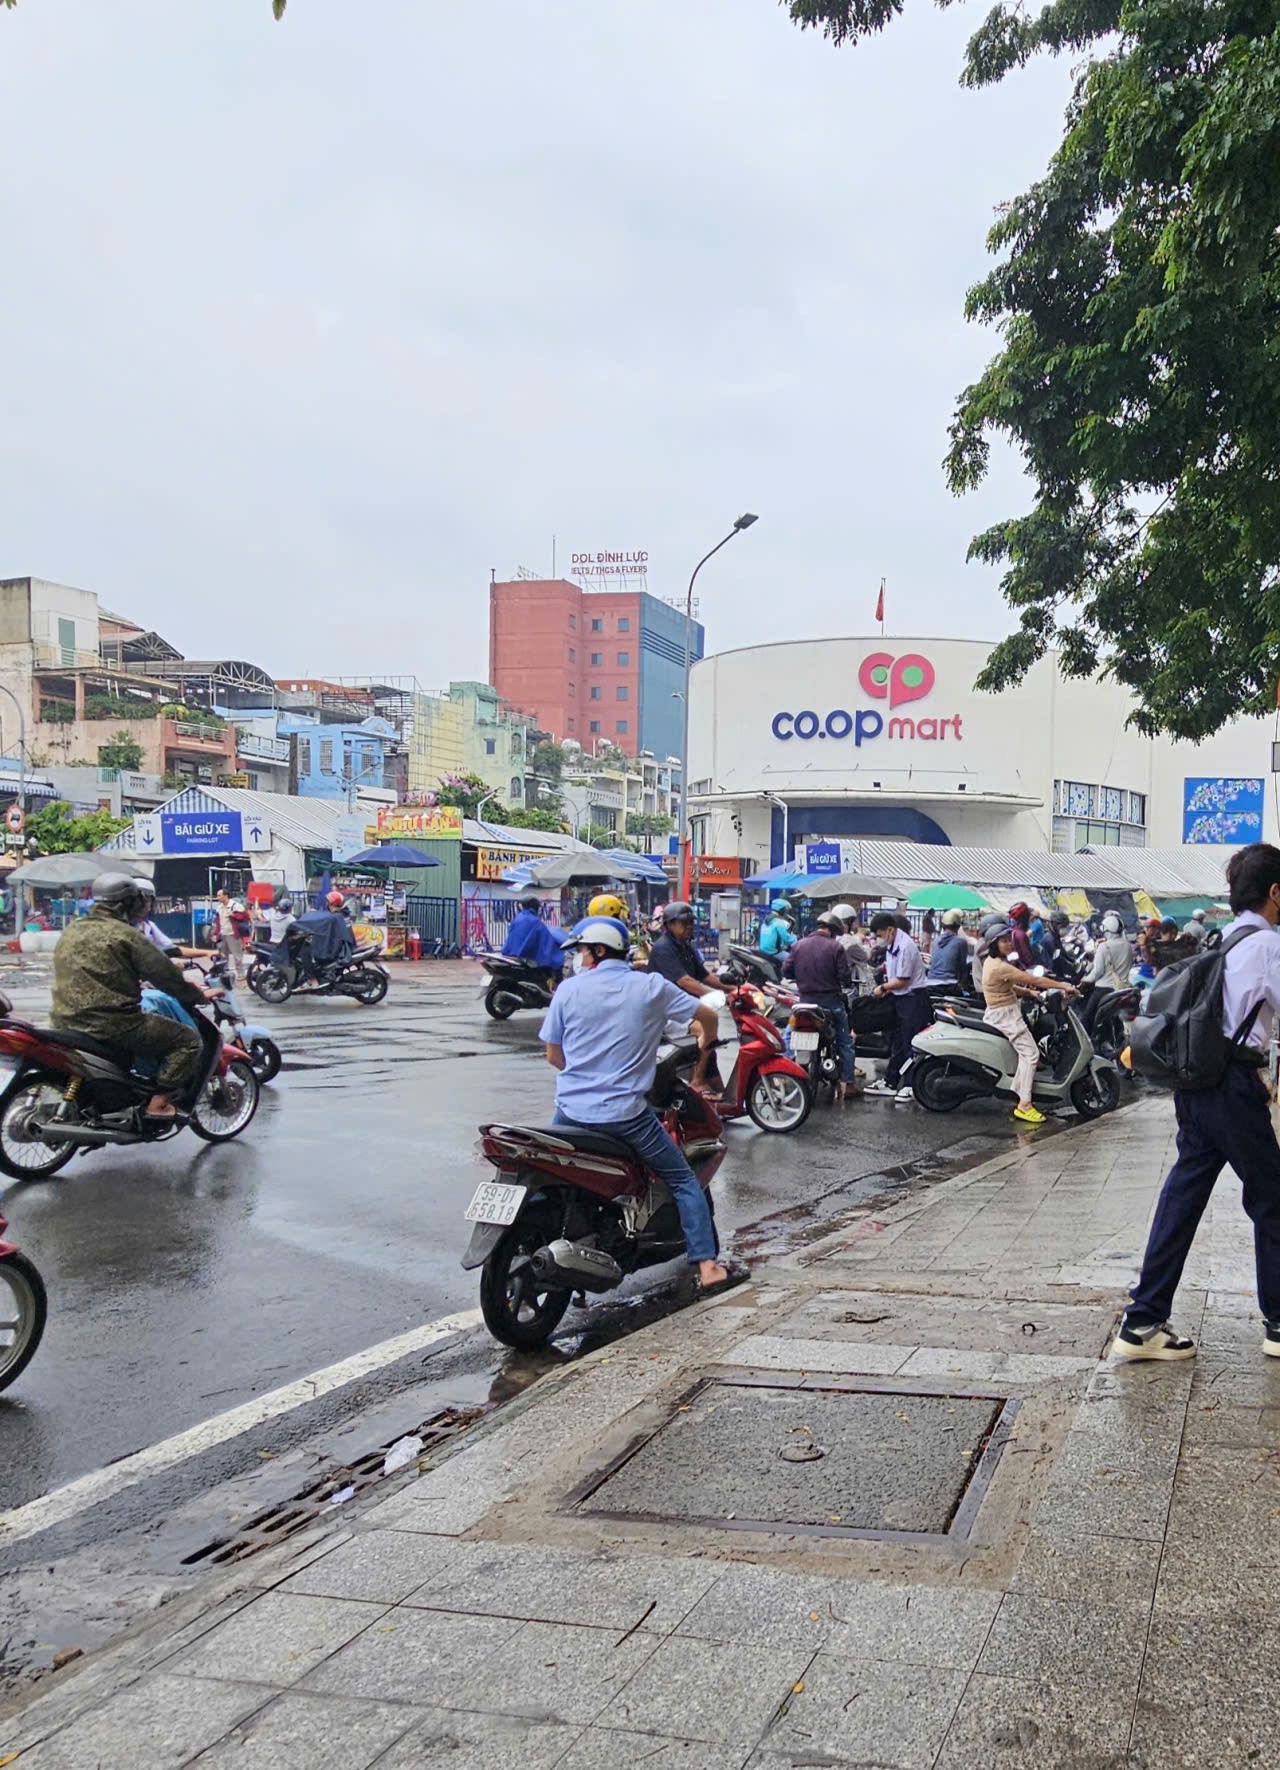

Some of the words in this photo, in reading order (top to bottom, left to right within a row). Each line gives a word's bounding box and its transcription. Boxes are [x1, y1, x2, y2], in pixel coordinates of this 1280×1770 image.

[572, 553, 594, 563] DOL
[597, 550, 622, 562] ĐÌNH
[621, 565, 647, 574] FLYERS
[175, 822, 193, 835] BÃI
[194, 822, 214, 835] GIỮ
[215, 823, 230, 834] XE
